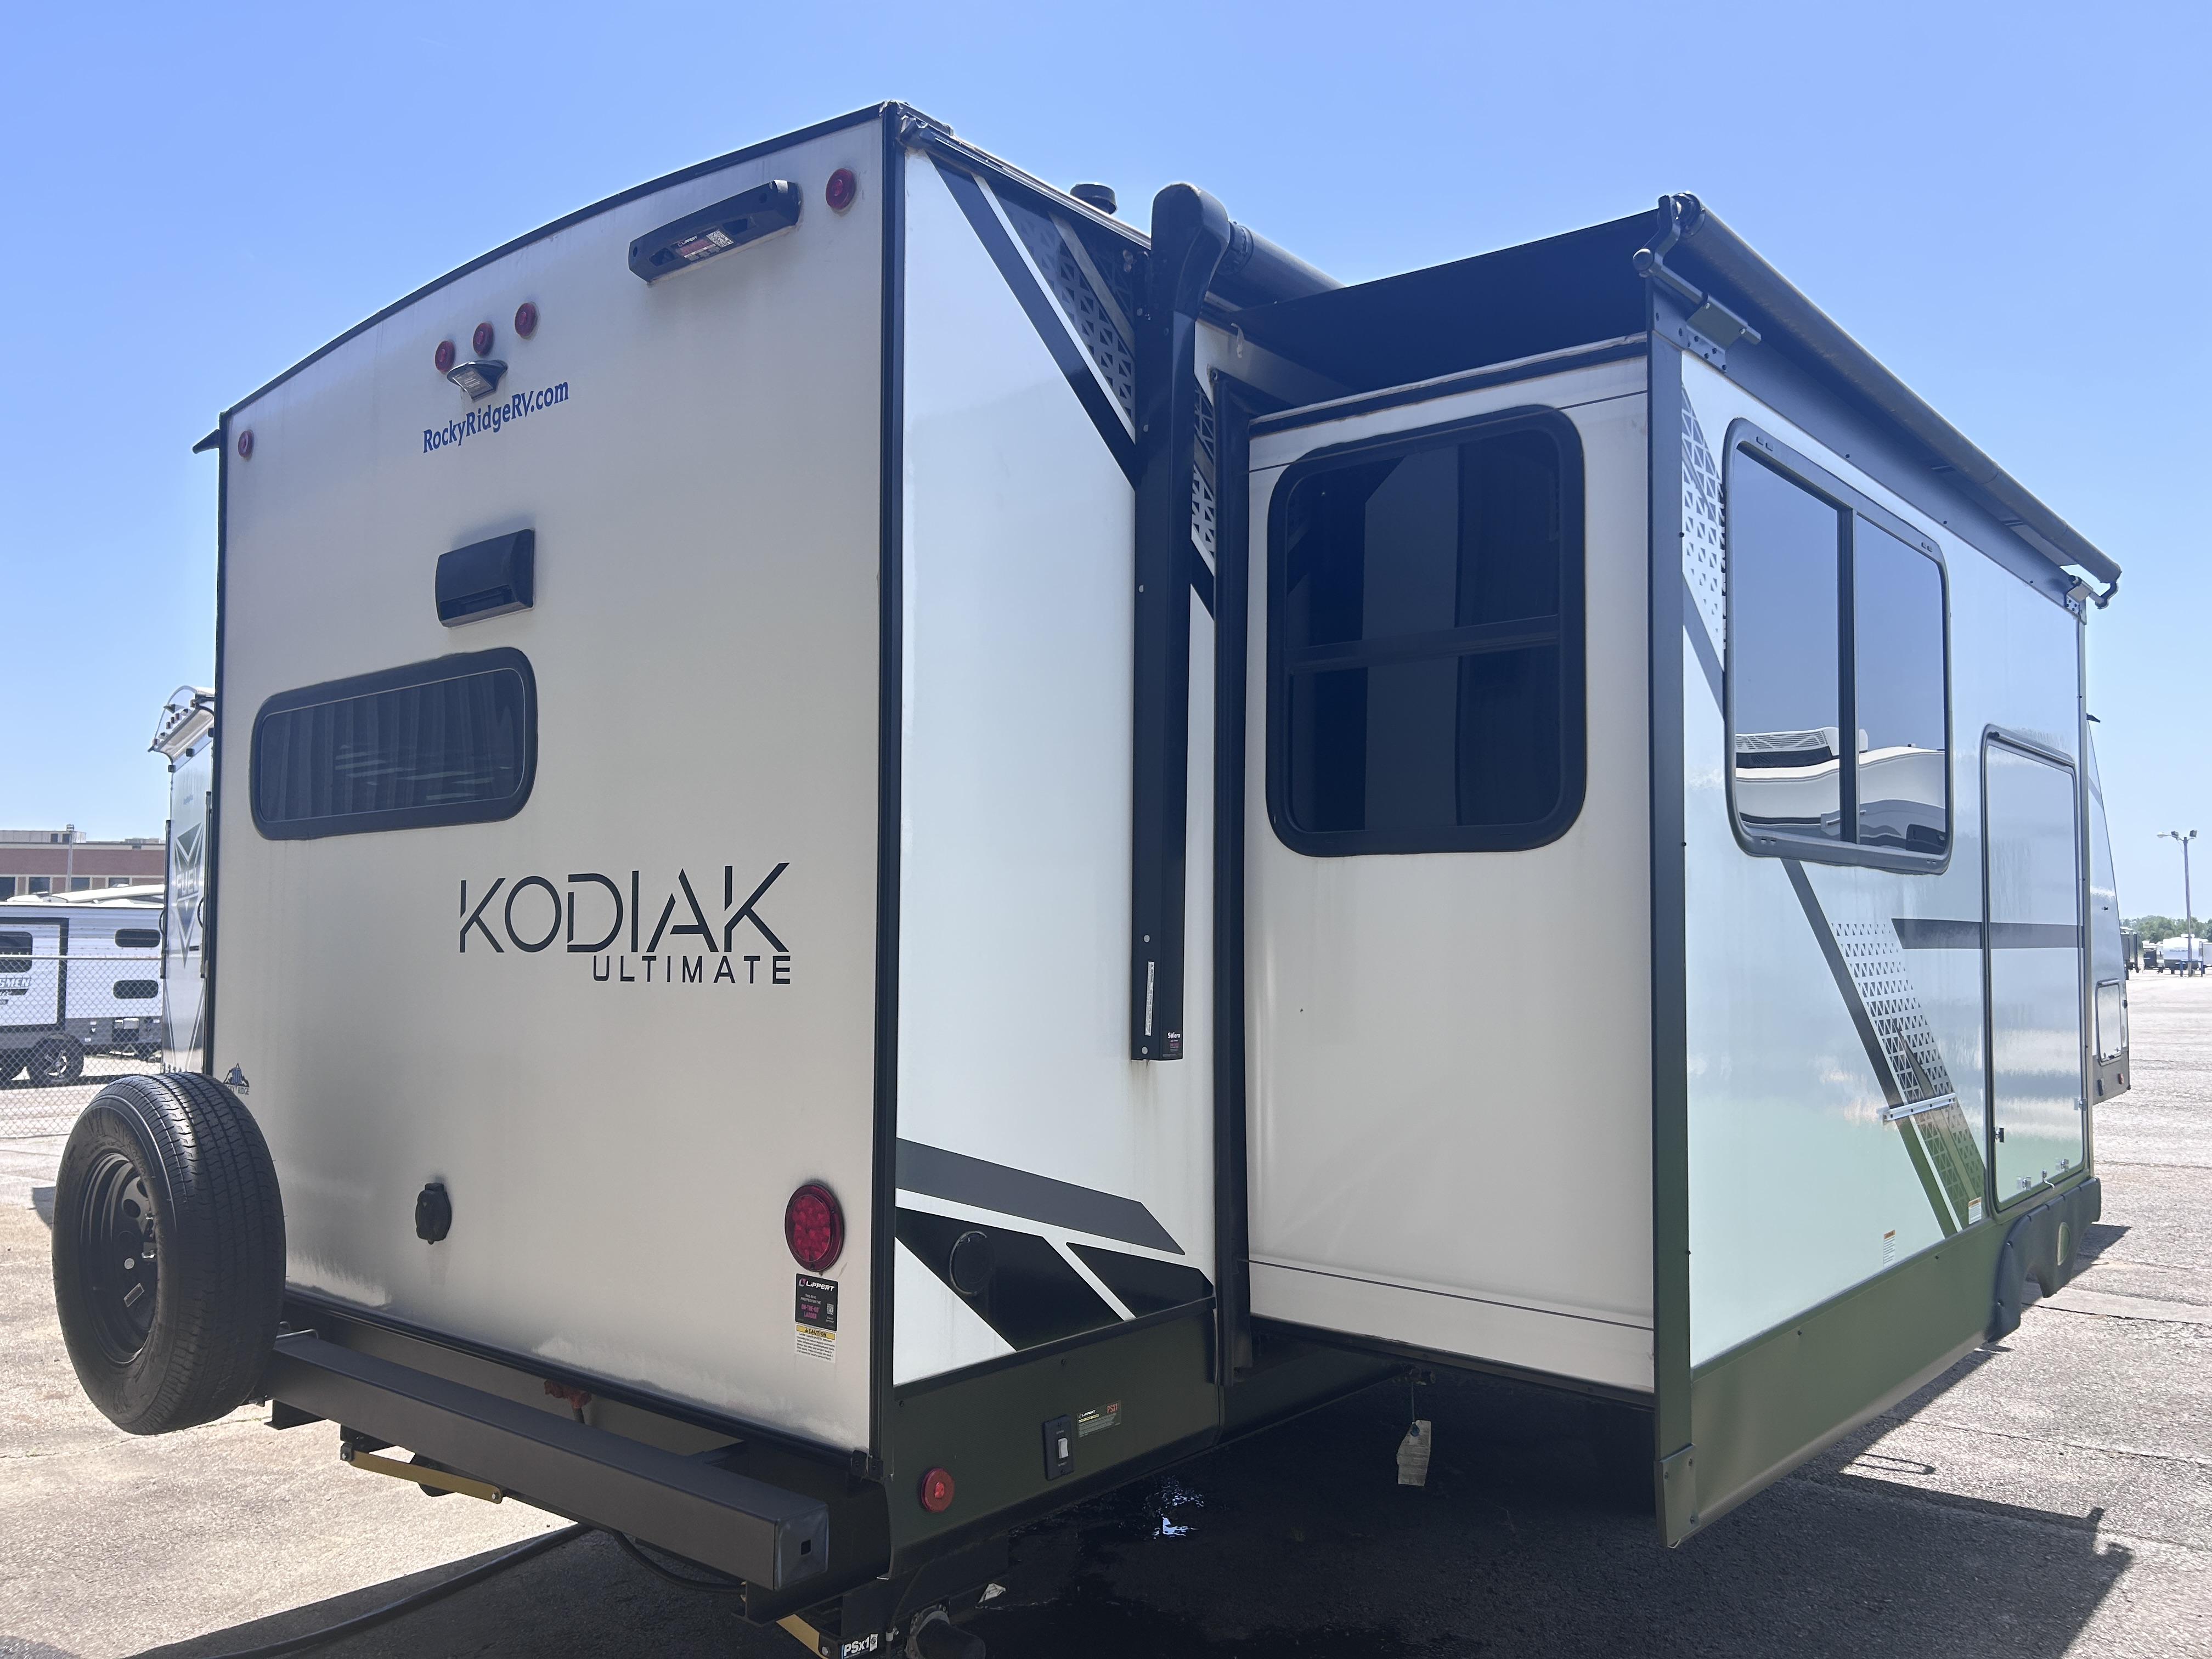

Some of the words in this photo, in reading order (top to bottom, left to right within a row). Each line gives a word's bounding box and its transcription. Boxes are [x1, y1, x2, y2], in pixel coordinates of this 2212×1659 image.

[423, 382, 569, 453] RockyRidgeRV.com
[177, 867, 199, 896] FUEL
[459, 862, 790, 953] KODIAK
[593, 955, 791, 985] ULTIMATE
